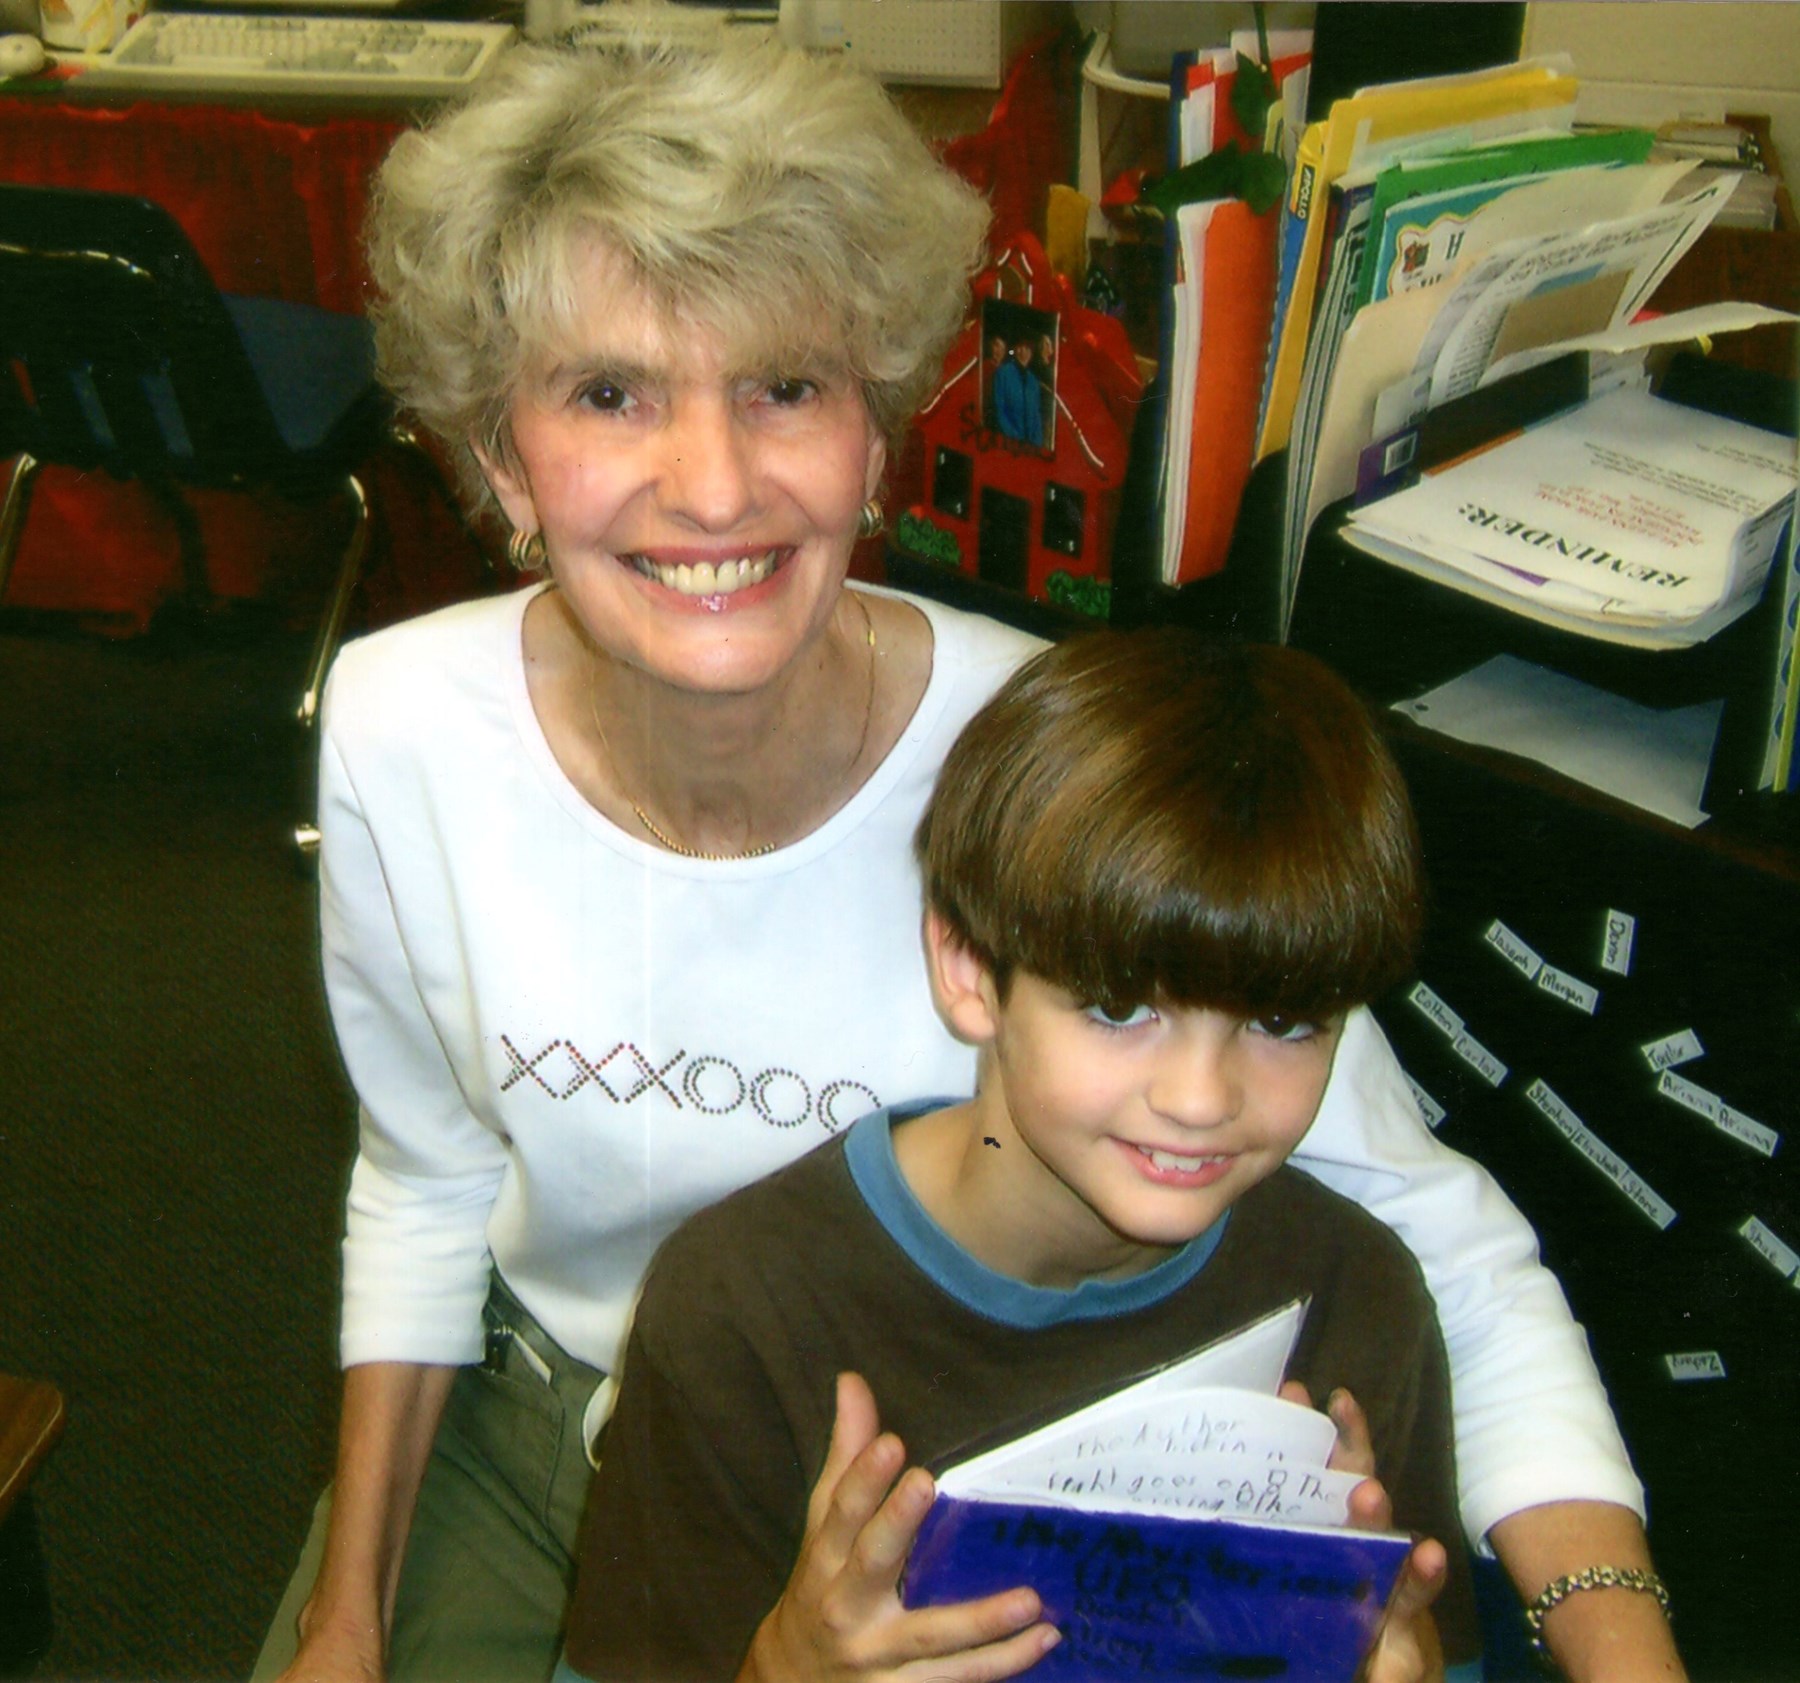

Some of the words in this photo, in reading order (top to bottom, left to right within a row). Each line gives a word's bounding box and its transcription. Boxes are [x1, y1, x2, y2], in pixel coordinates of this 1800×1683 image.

[1296, 167, 1316, 219] APOLLO
[1457, 503, 1691, 590] REMINDER:
[1413, 987, 1455, 1033] Colton
[1541, 971, 1585, 1006] Morgan
[500, 1033, 883, 1134] XXXOOO
[1529, 1081, 1574, 1137] Stephen
[1074, 1559, 1190, 1604] UFO
